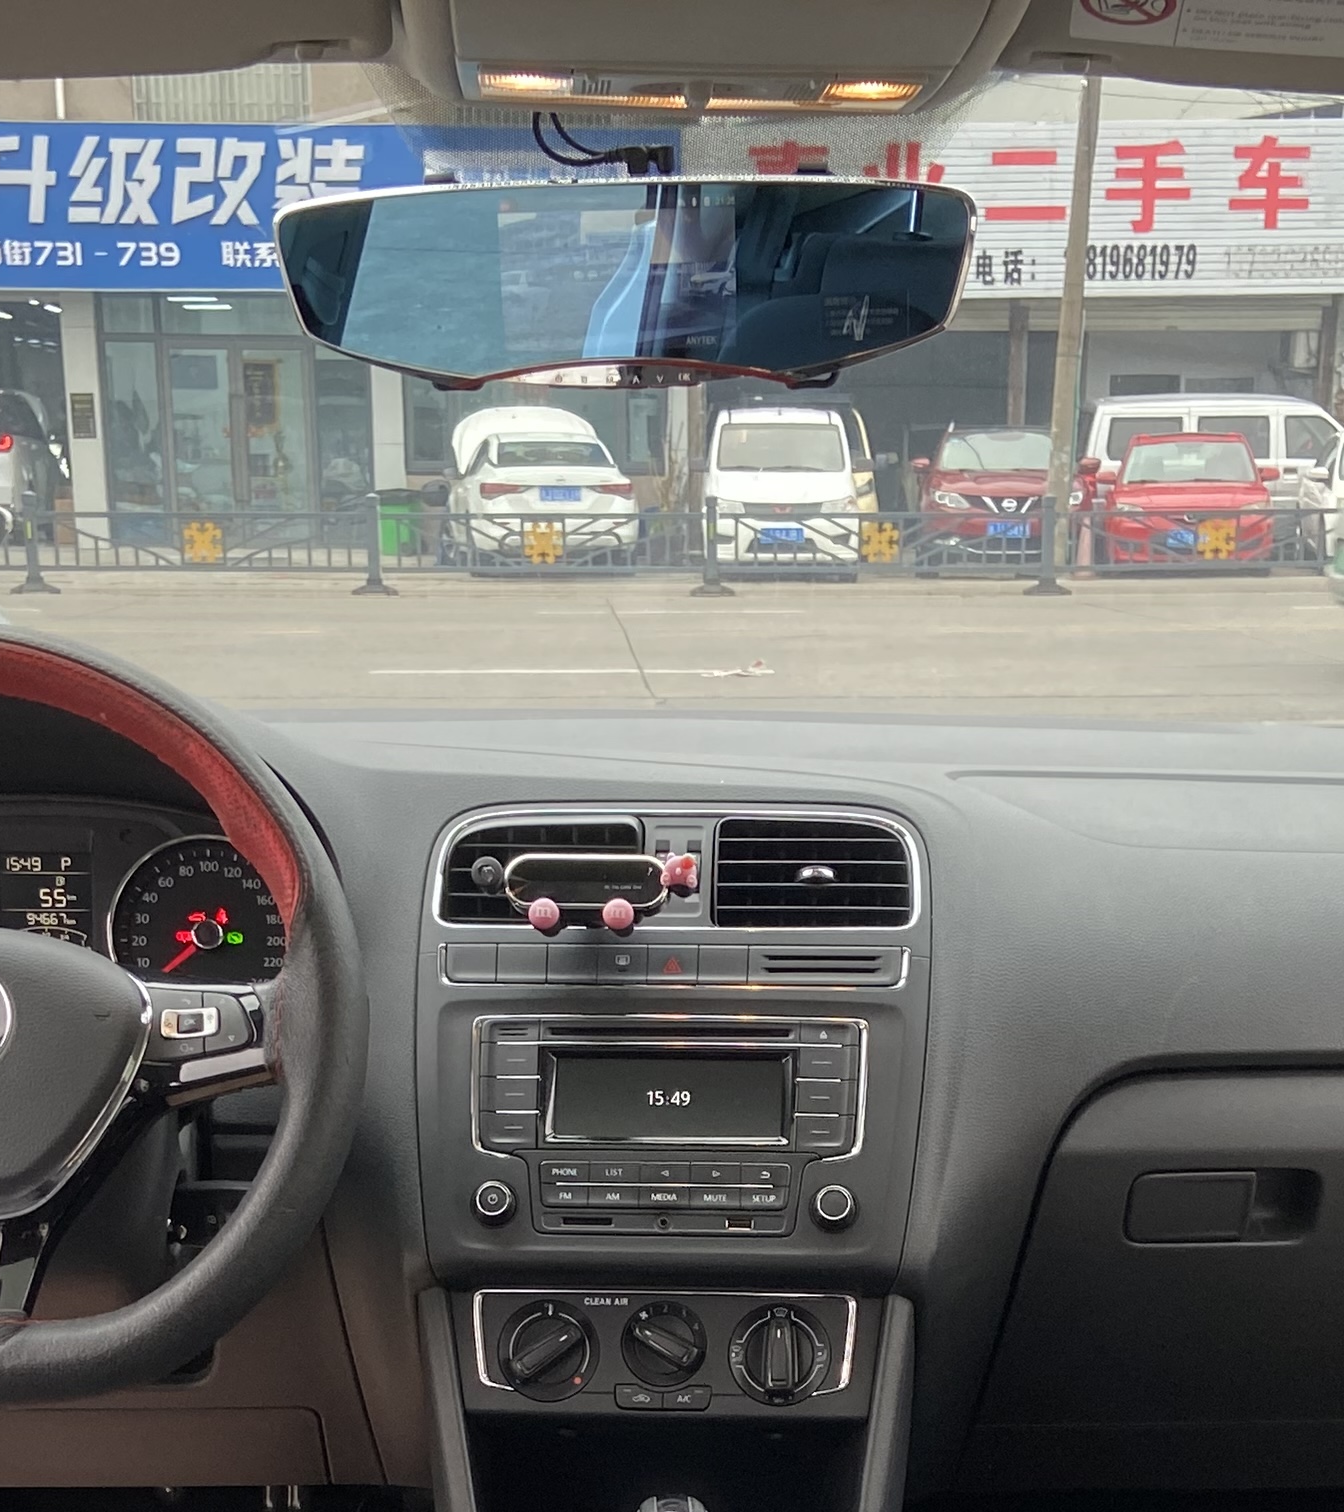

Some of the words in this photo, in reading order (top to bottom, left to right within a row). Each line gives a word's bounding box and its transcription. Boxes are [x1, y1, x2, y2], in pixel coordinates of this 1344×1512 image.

[1065, 243, 1197, 281] 819681979
[60, 856, 72, 872] P
[199, 860, 219, 872] 100
[179, 865, 194, 877] 80
[223, 866, 242, 878] 120
[158, 876, 174, 888] 60
[242, 878, 261, 890] 140
[39, 888, 67, 908] 55
[142, 892, 159, 903] 40
[135, 914, 150, 924] 30
[132, 936, 147, 947] 20
[137, 957, 150, 968] 10
[263, 956, 284, 968] 220
[646, 1090, 691, 1107] 15:49
[551, 1168, 578, 1177] PHONE
[605, 1168, 623, 1177] LIST
[558, 1192, 572, 1200] FM
[605, 1192, 620, 1201] AM
[650, 1193, 678, 1202] MEDIA
[703, 1194, 727, 1203] MUTE
[752, 1194, 776, 1203] SETUP
[584, 1297, 611, 1306] CLEAN
[613, 1297, 629, 1306] AIR
[676, 1394, 691, 1404] A/C
